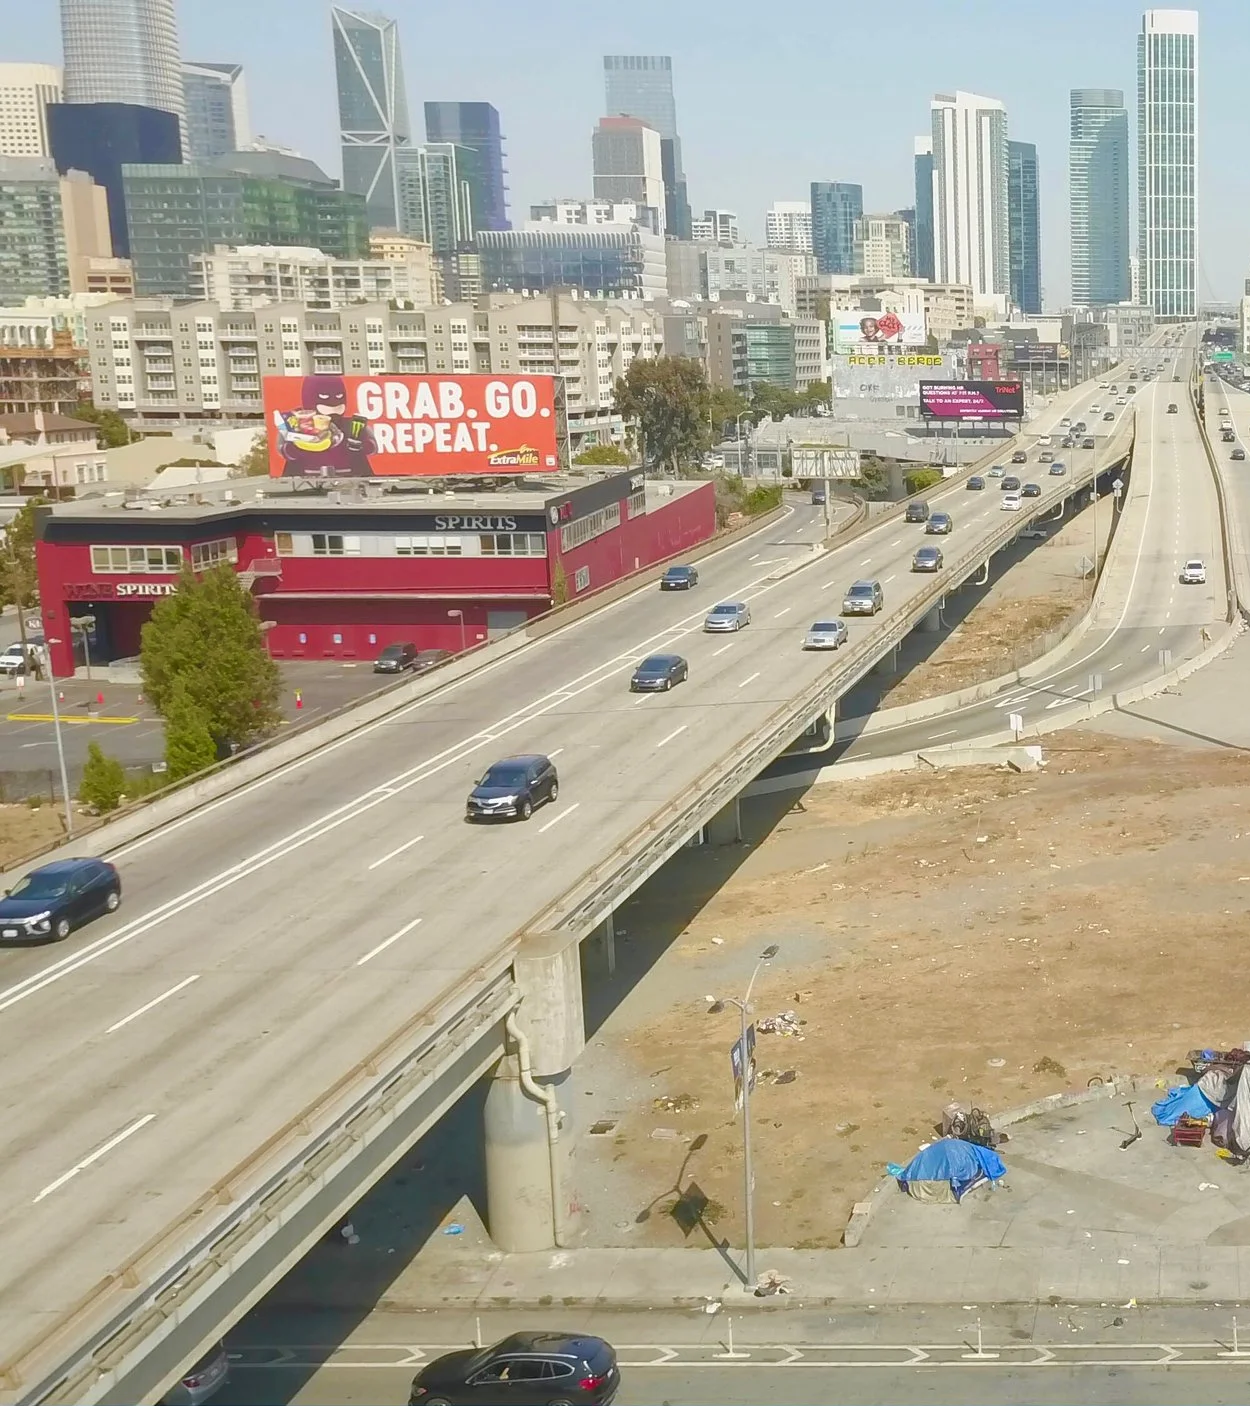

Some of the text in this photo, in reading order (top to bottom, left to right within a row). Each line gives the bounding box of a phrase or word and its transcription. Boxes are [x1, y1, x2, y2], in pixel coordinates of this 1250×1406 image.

[356, 381, 550, 420] GRAB. GO.
[374, 422, 498, 455] REPEAT.
[490, 454, 539, 465] ExtraMile
[435, 516, 517, 531] SPIRITS
